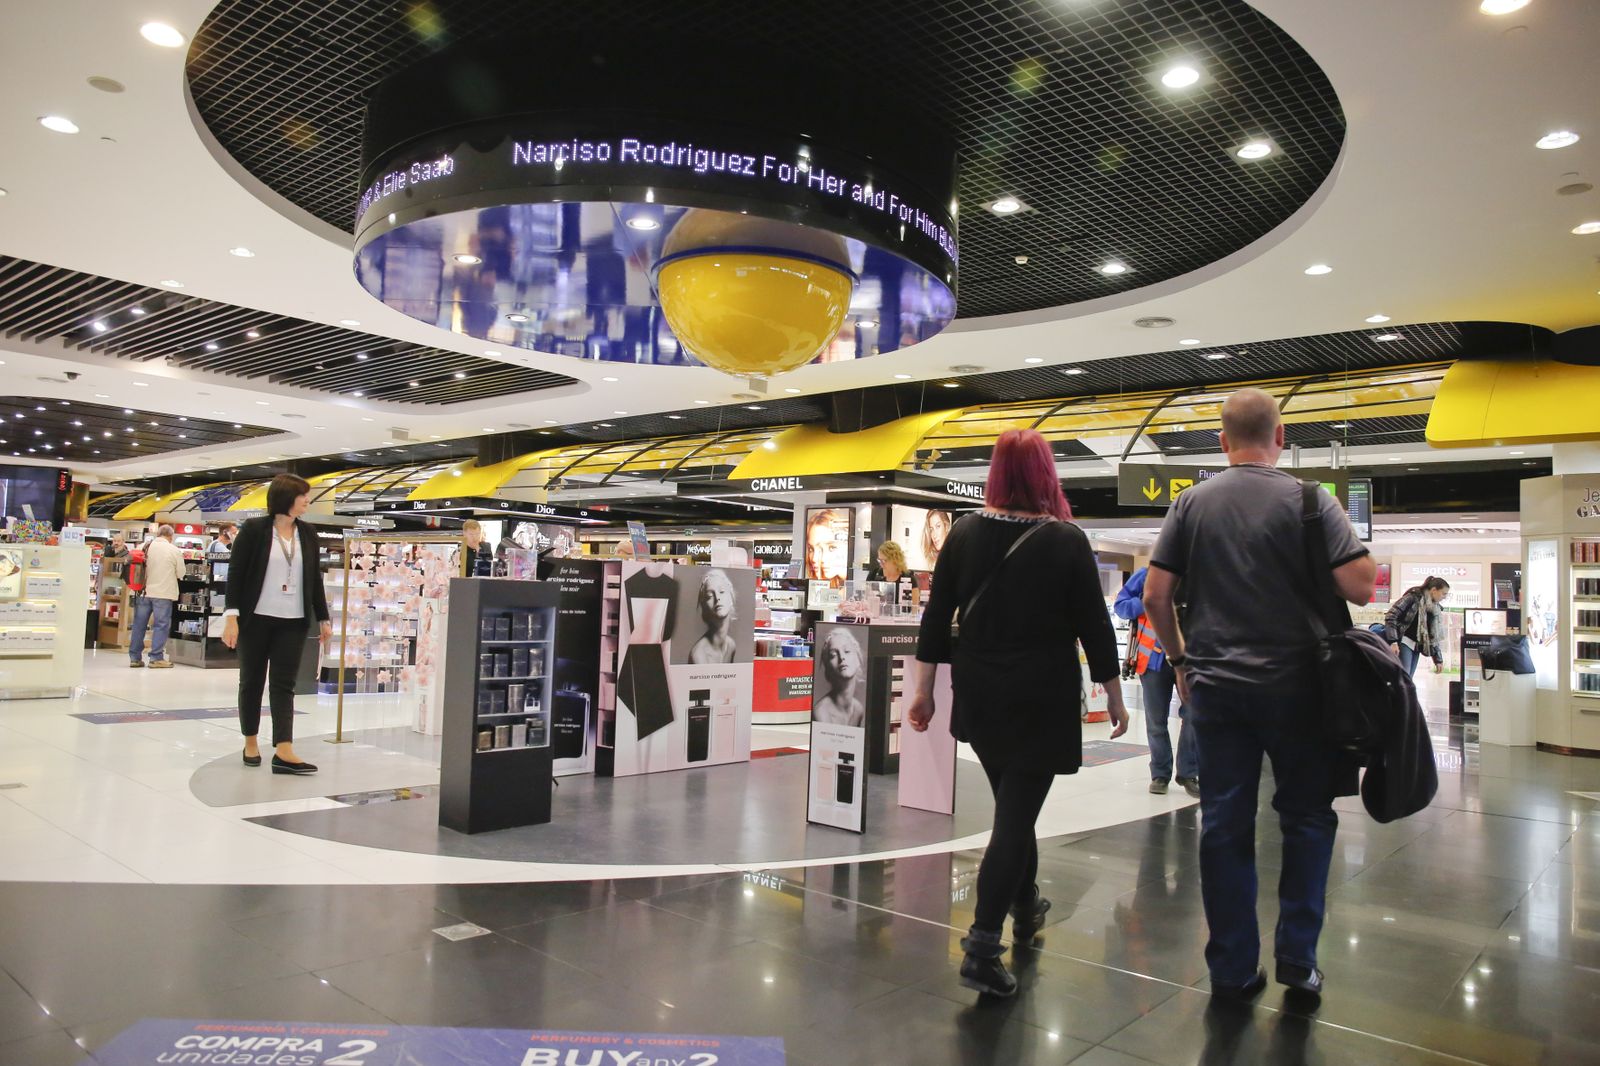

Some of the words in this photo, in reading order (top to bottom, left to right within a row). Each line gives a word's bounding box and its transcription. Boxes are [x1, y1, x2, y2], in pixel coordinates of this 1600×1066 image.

[383, 171, 406, 196] Elie
[411, 154, 454, 184] Saab
[513, 138, 611, 165] Narciso
[621, 138, 756, 174] Rodriguez
[763, 154, 801, 184] For
[808, 166, 847, 196] Her
[852, 184, 885, 211] and
[889, 194, 914, 224] For
[915, 208, 938, 241] Him
[751, 478, 803, 491] CHANEL
[946, 481, 985, 499] CHANEL
[1583, 487, 1600, 502] Je
[413, 500, 427, 510] Dior
[536, 504, 556, 515] Dior
[1576, 504, 1600, 518] GA
[357, 518, 380, 526] PRADA
[754, 545, 783, 554] GIORGIO
[1412, 566, 1457, 576] swatch
[566, 577, 595, 585] rodriguez
[761, 580, 782, 589] ANEL
[881, 634, 913, 643] narciso
[530, 1034, 620, 1044] PERFUMERY
[638, 1038, 721, 1047] COSMETICS
[174, 1034, 323, 1053] COMPRA
[322, 1039, 378, 1066] 2
[520, 1047, 643, 1066] BUY
[156, 1049, 317, 1066] unidades
